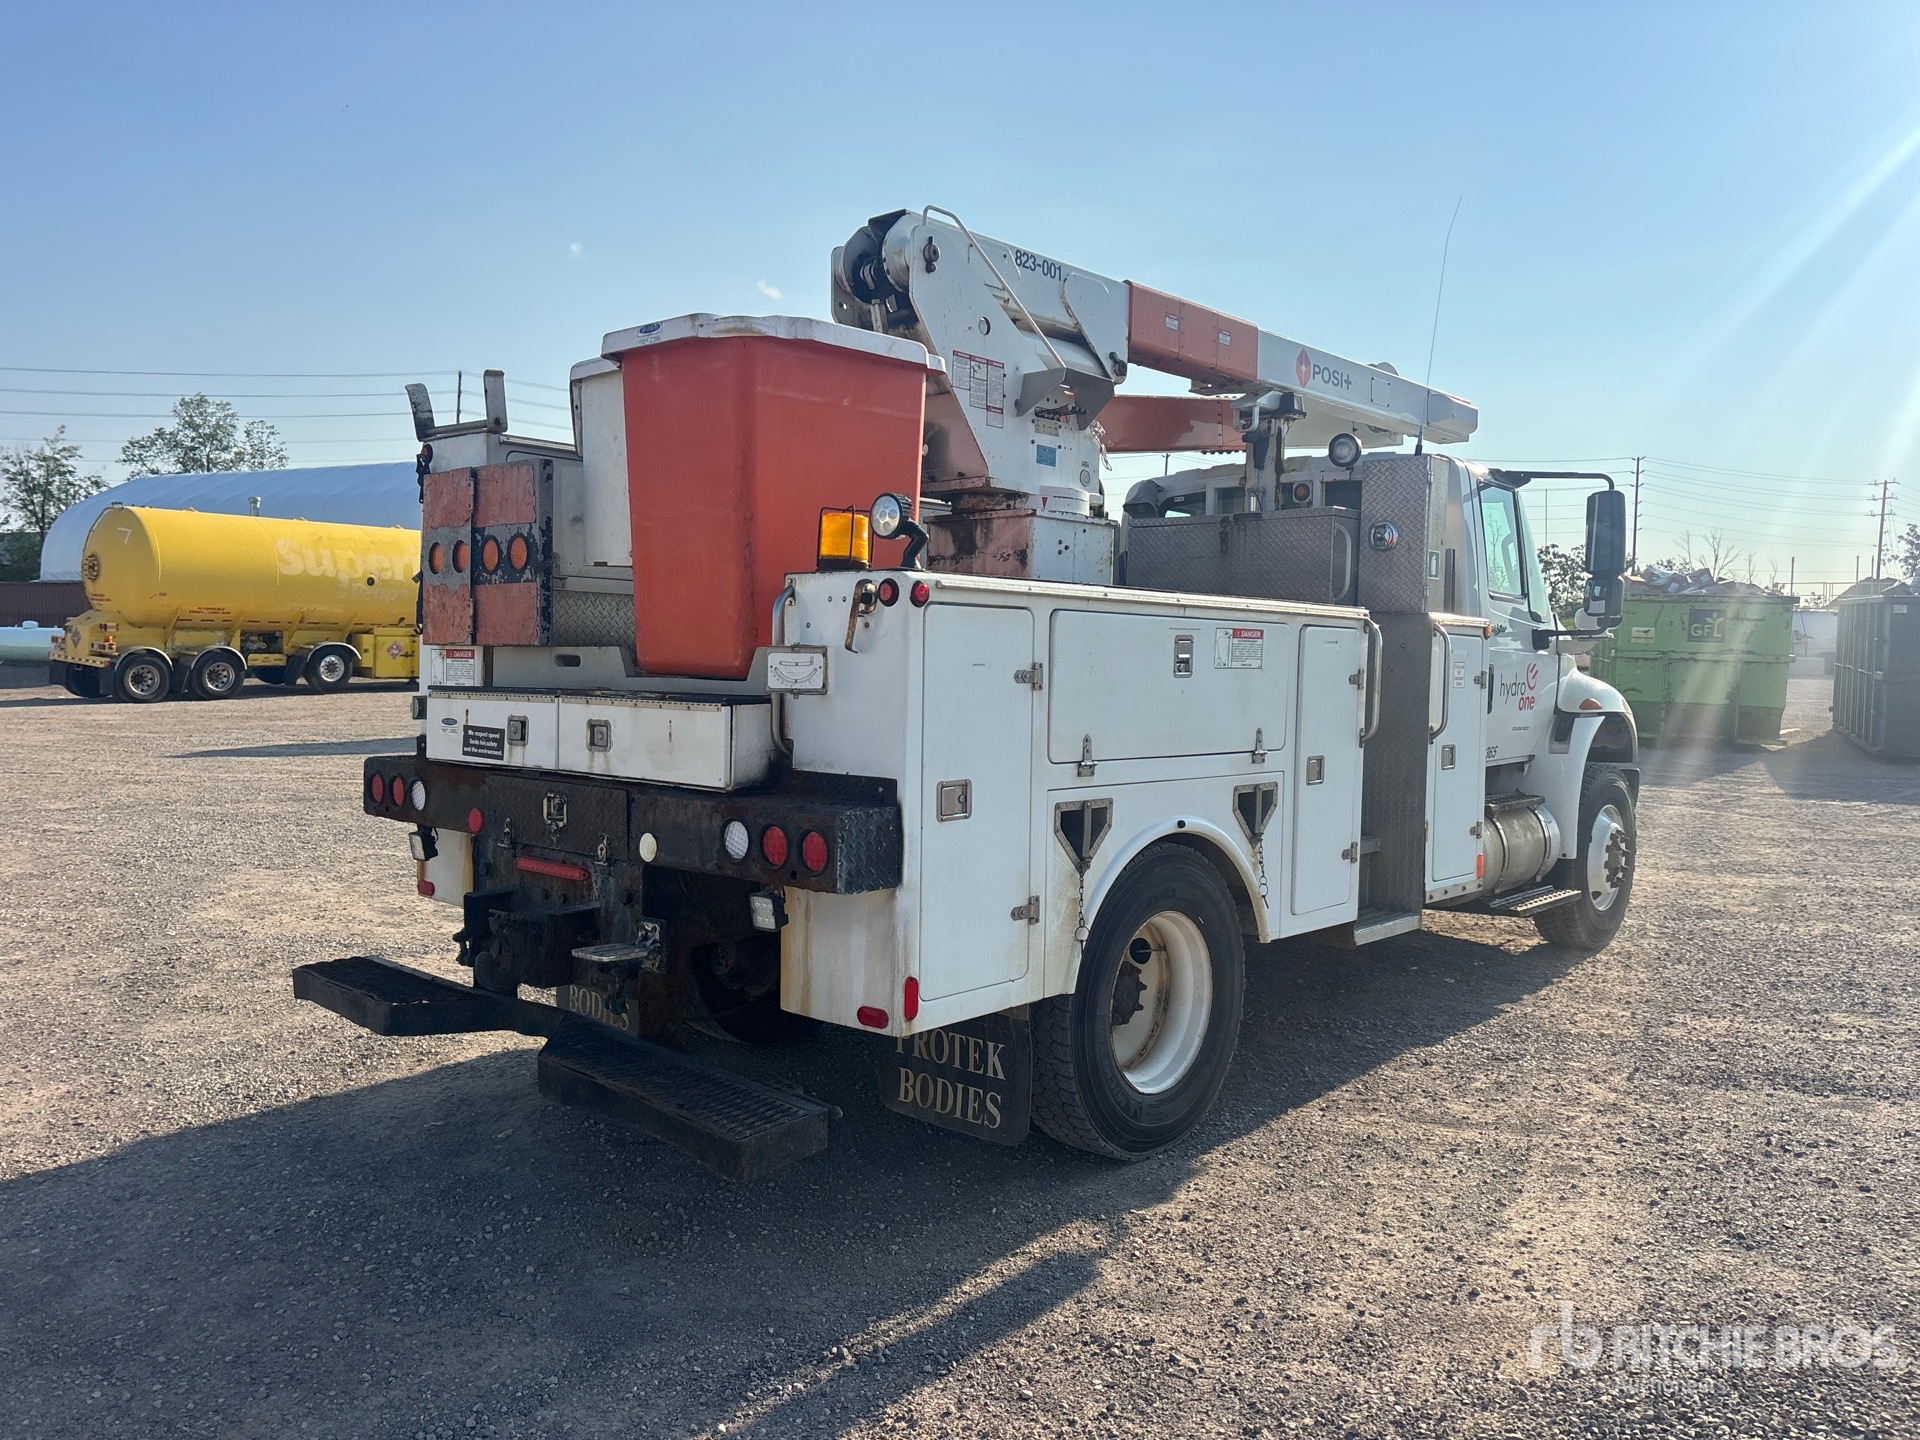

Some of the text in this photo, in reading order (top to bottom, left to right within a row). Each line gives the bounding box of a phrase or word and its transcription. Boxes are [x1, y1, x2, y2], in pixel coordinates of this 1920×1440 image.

[1015, 249, 1062, 281] 823-001
[1312, 363, 1352, 390] POSI+
[1241, 630, 1261, 638] DANGER
[1690, 620, 1722, 637] GFL
[1499, 672, 1527, 704] hydro
[1518, 695, 1535, 711] one
[896, 1066, 1002, 1129] BODIES
